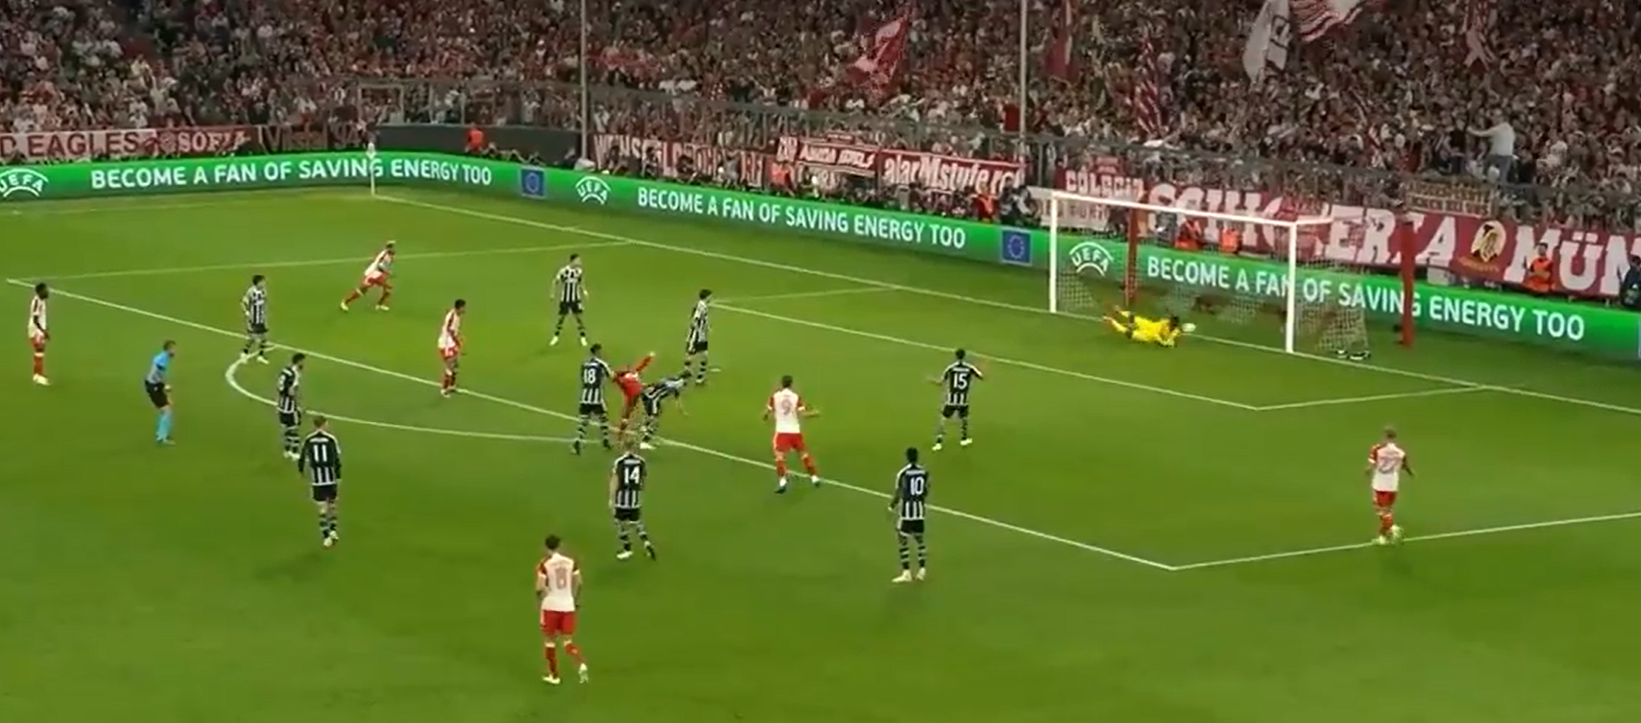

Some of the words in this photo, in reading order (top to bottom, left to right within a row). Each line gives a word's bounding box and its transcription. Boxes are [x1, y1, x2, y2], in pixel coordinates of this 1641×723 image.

[28, 131, 140, 157] EAGLES
[178, 131, 247, 153] SOFIA
[91, 166, 187, 189] BECOME
[193, 166, 209, 185] A
[214, 164, 257, 183] FAN
[264, 161, 292, 181] OF
[299, 158, 384, 179] SAVING
[391, 159, 462, 183] ENERGY
[462, 163, 492, 186] TOO
[577, 181, 608, 201] UEFA
[638, 186, 704, 214] BECOME
[707, 195, 719, 216] A
[723, 198, 754, 221] FAN
[759, 202, 781, 224] OF
[785, 205, 849, 233] SAVING
[854, 213, 925, 244] ENERGY
[929, 223, 967, 249] TOO
[1071, 247, 1109, 273] UEFA
[1147, 255, 1230, 288] BECOME
[1236, 269, 1250, 292] A
[1256, 270, 1293, 297] FAN
[1303, 278, 1331, 303] OF
[1338, 282, 1421, 317] SAVING
[1429, 295, 1526, 332] ENERGY
[1532, 308, 1585, 341] TOO
[584, 367, 596, 385] 18
[953, 372, 968, 390] 15
[781, 398, 792, 416] 9
[313, 444, 328, 463] 11
[624, 465, 640, 485] 14
[910, 475, 925, 496] 10
